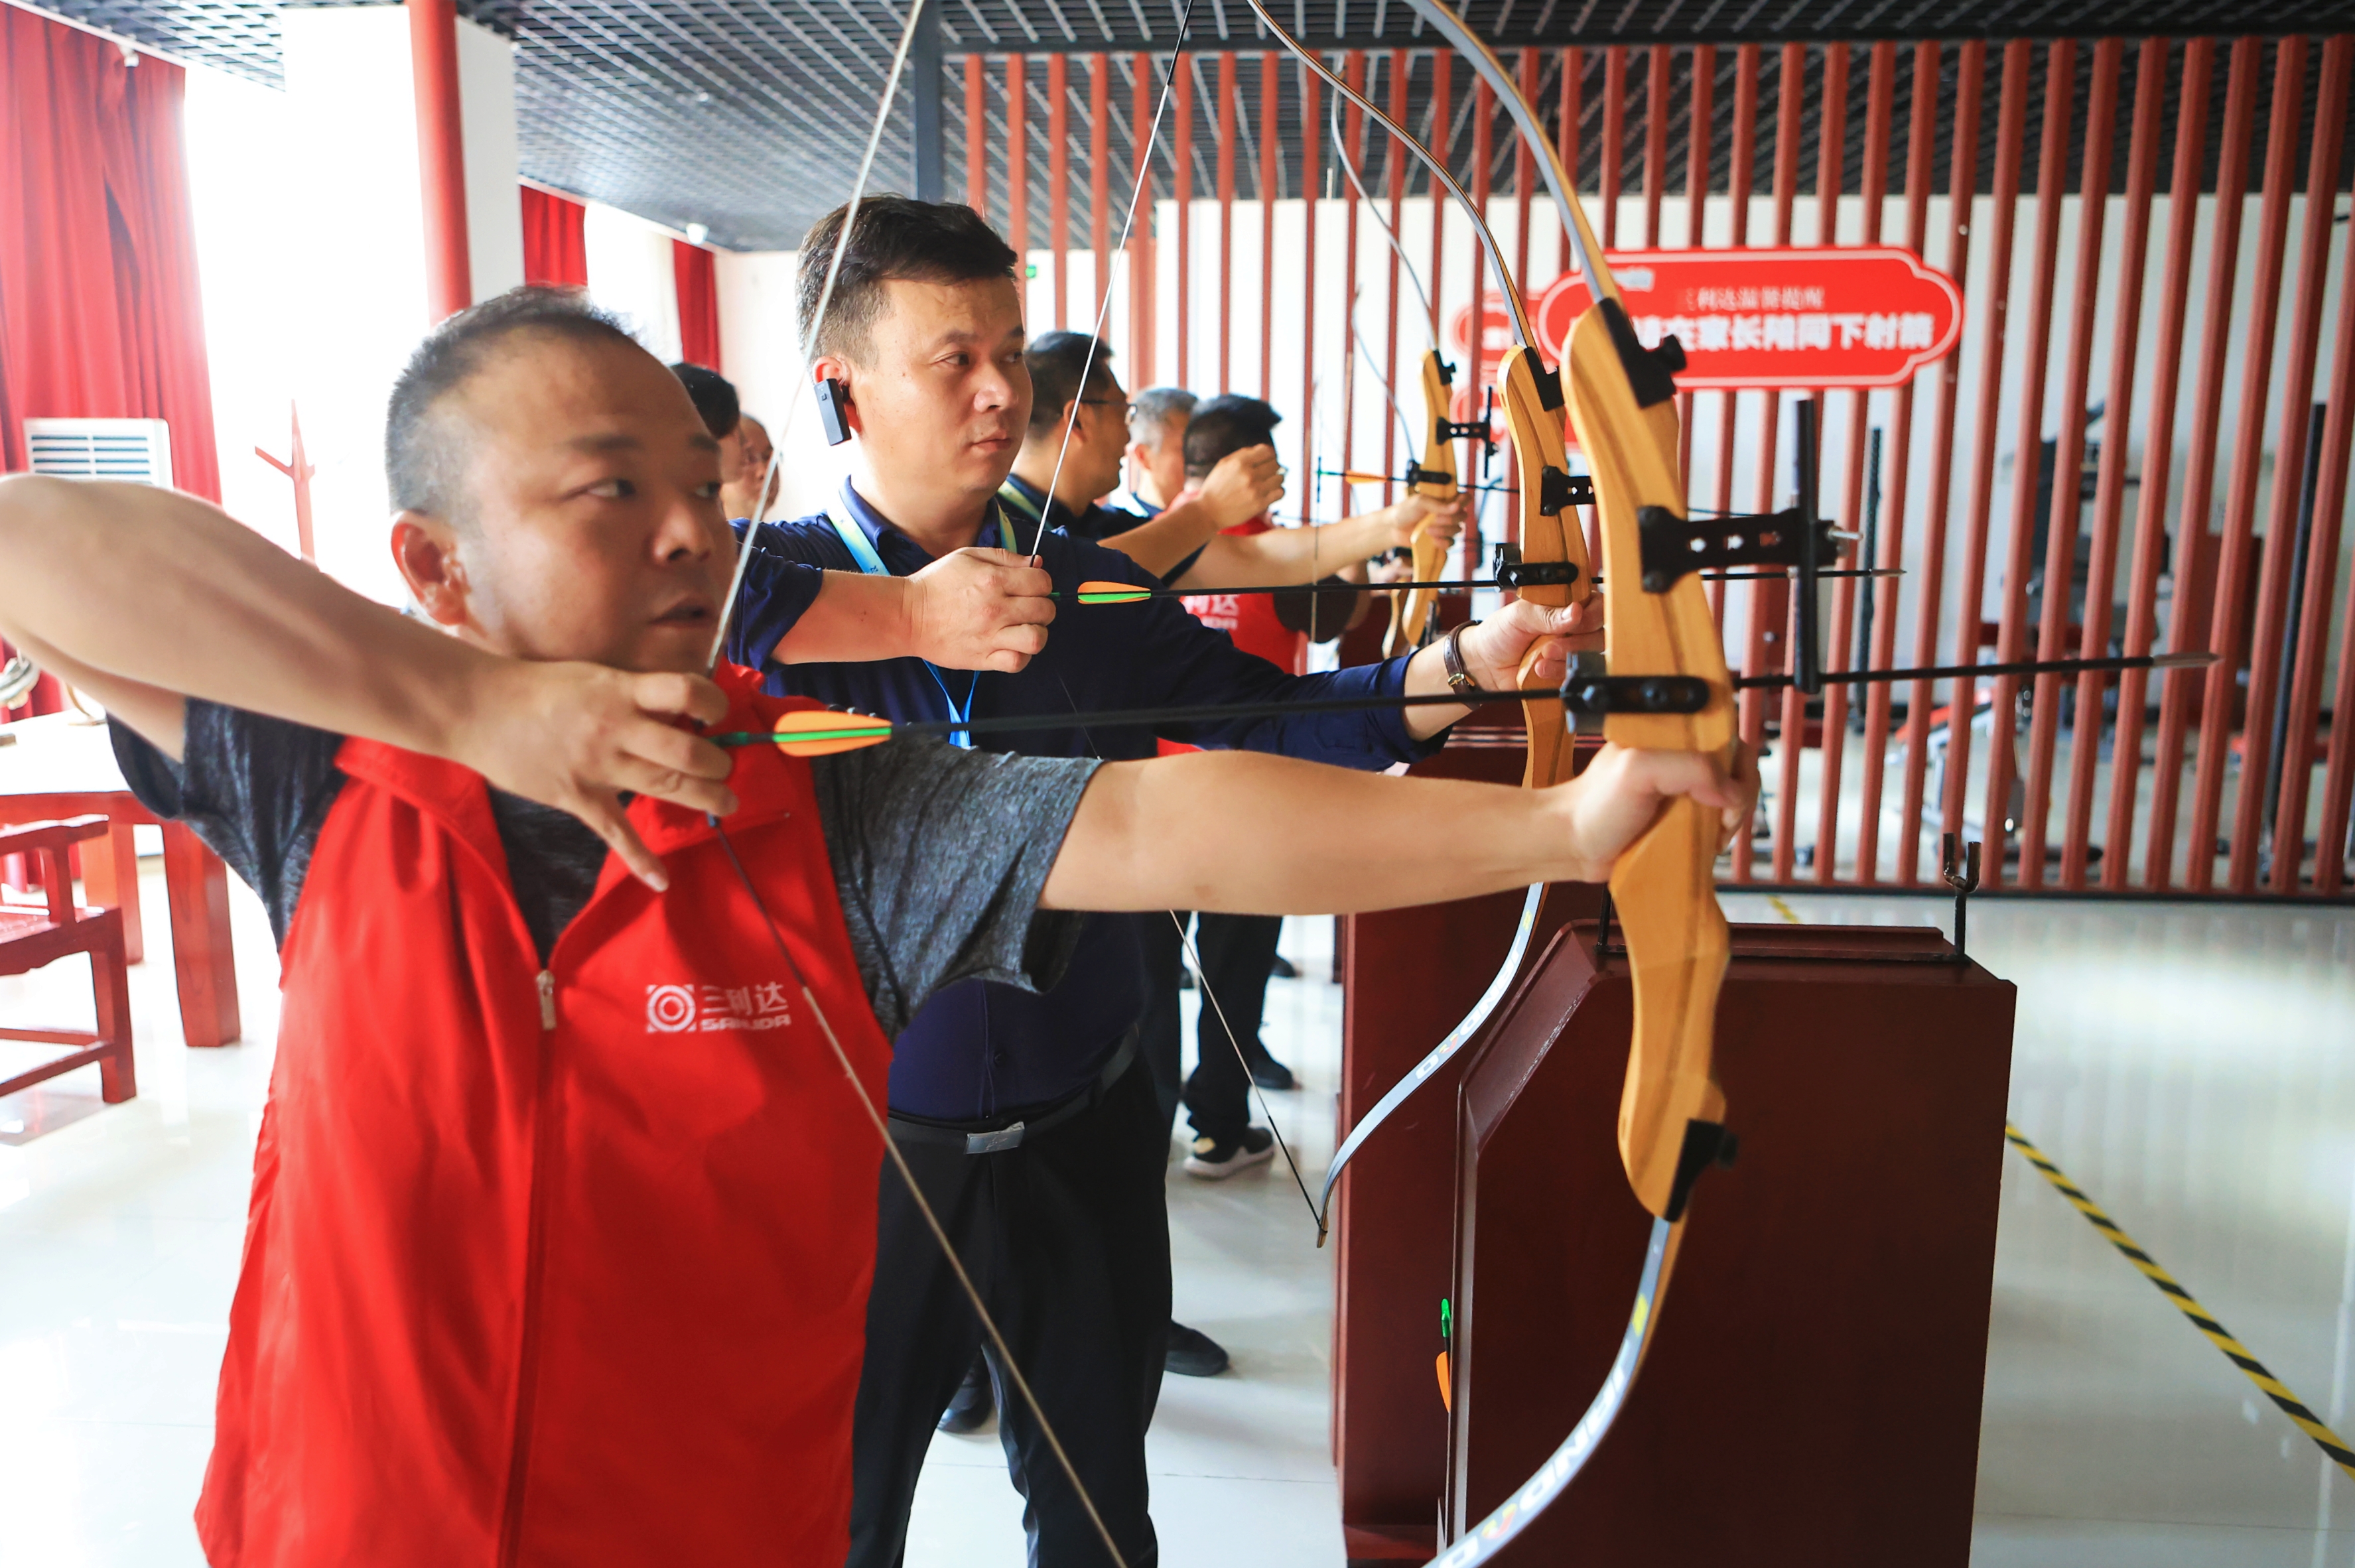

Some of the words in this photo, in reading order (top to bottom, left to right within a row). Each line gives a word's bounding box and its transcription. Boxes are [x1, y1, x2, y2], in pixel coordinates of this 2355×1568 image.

[1568, 313, 1935, 352] 请在家长陪同下射箭
[1183, 594, 1240, 617] 利达
[701, 981, 789, 1016] 三利达
[1415, 935, 1521, 1080] JANDAO
